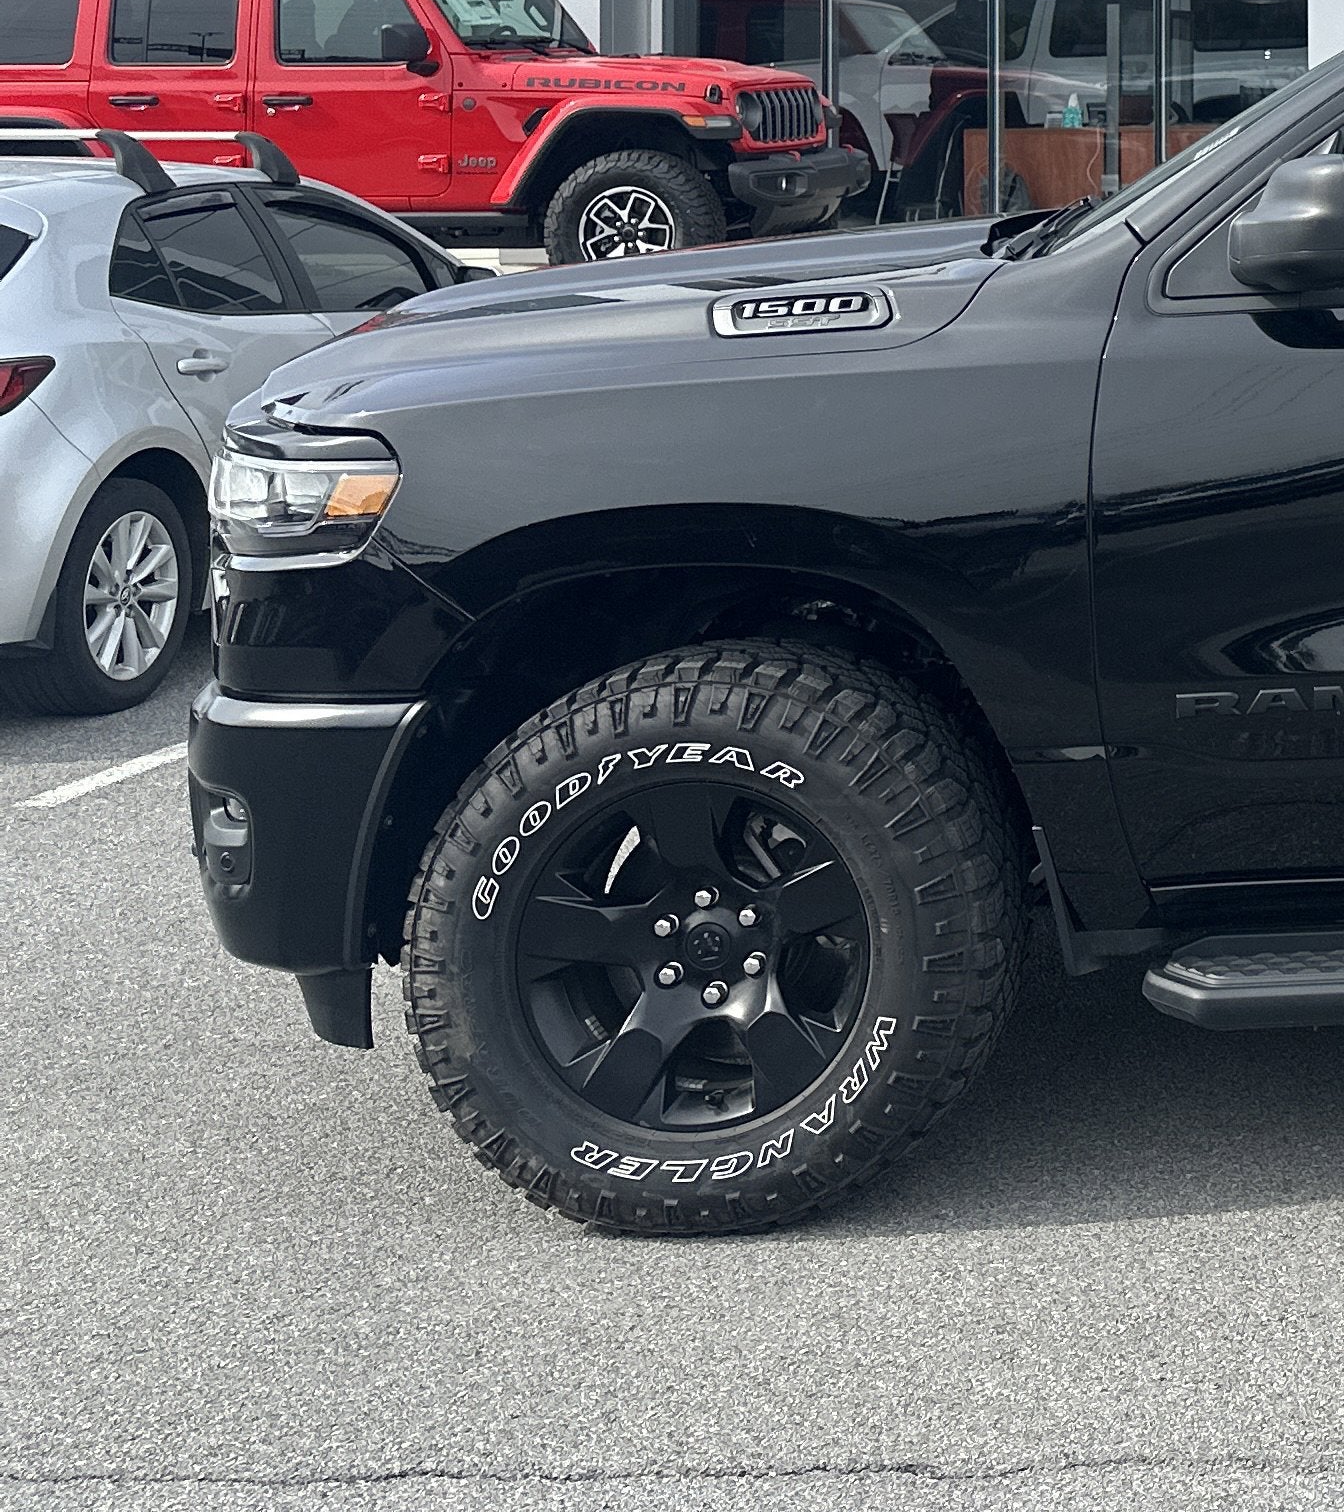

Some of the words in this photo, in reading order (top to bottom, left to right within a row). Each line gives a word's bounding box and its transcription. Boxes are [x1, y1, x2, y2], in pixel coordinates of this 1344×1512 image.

[526, 76, 686, 92] RUBICON
[457, 153, 497, 169] Jeep
[741, 295, 863, 319] 1500
[570, 1016, 897, 1183] WRANGLER
